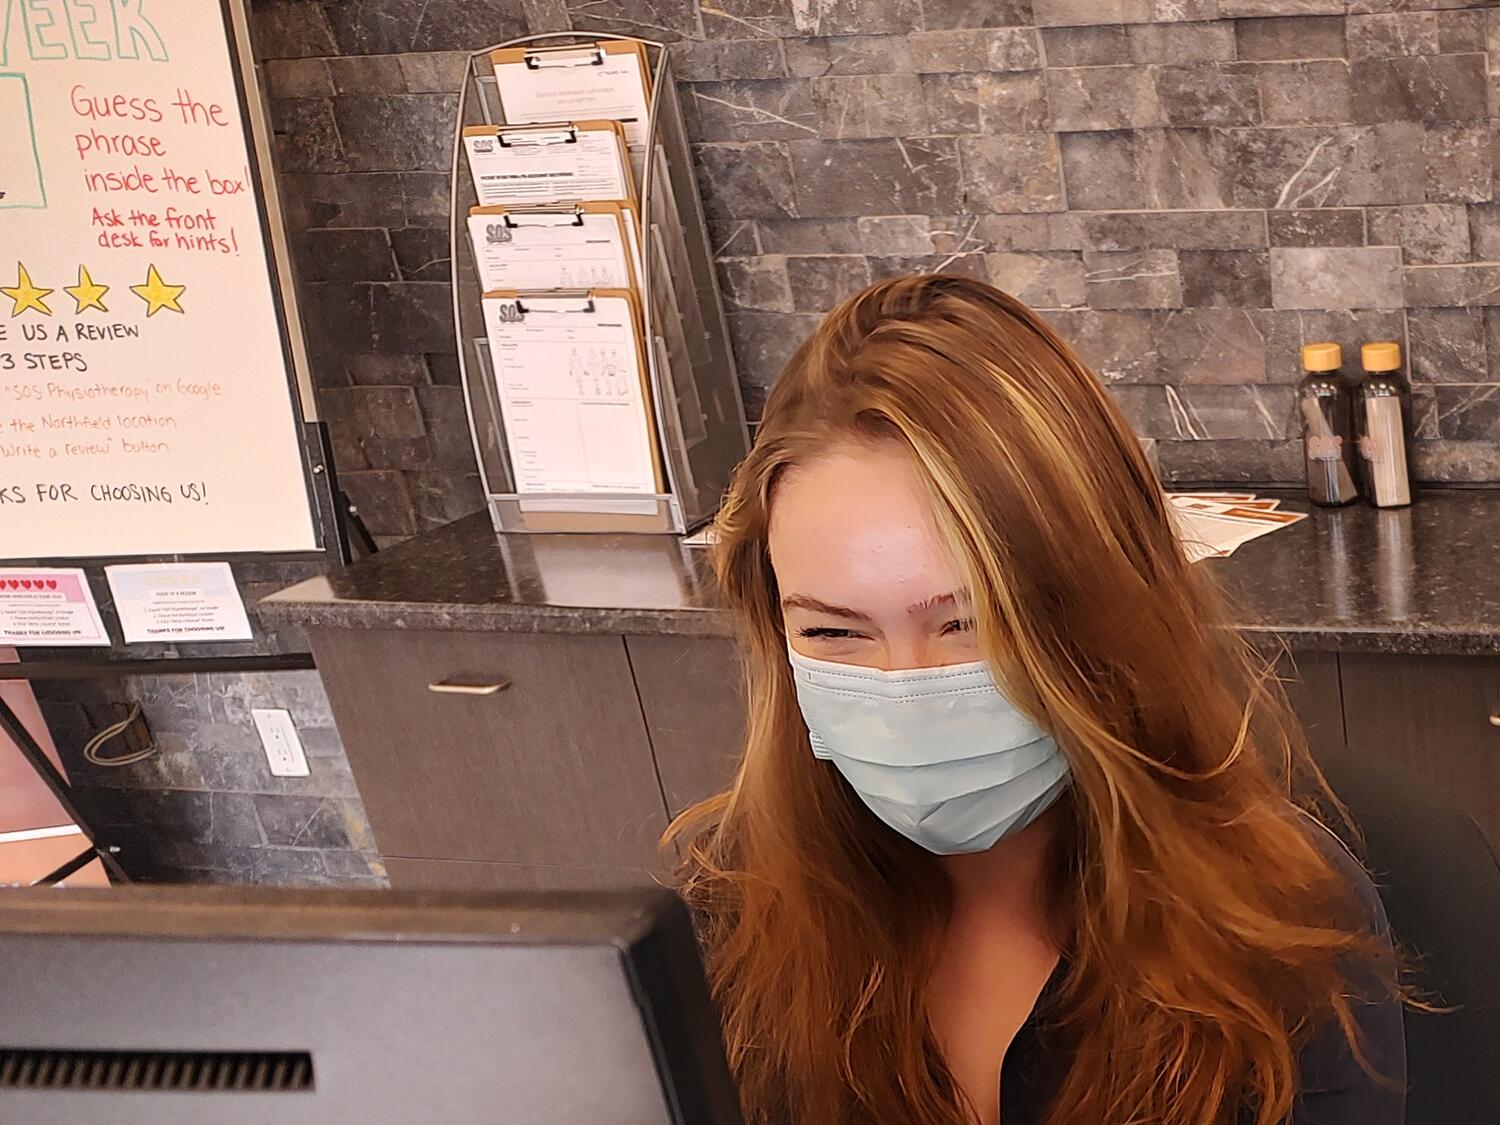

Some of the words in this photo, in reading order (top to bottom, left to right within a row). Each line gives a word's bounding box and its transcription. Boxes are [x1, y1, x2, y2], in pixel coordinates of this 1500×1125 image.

[71, 85, 163, 122] Guess
[171, 88, 229, 126] the
[75, 128, 166, 160] phrase
[84, 165, 158, 193] inside
[162, 167, 200, 194] the
[92, 208, 124, 227] Ask
[128, 209, 160, 227] the
[165, 207, 216, 230] front
[98, 229, 143, 248] desk
[150, 230, 169, 247] for
[175, 227, 240, 257] hints!
[22, 323, 48, 341] US
[56, 325, 69, 343] A
[75, 322, 139, 341] REVIEW
[0, 353, 15, 370] 3
[24, 352, 88, 372] STEPS
[177, 378, 222, 401] Google
[117, 414, 177, 429] location
[122, 437, 170, 453] button
[36, 483, 78, 502] FOR
[91, 483, 172, 503] CHOOSING
[180, 481, 209, 505] US!
